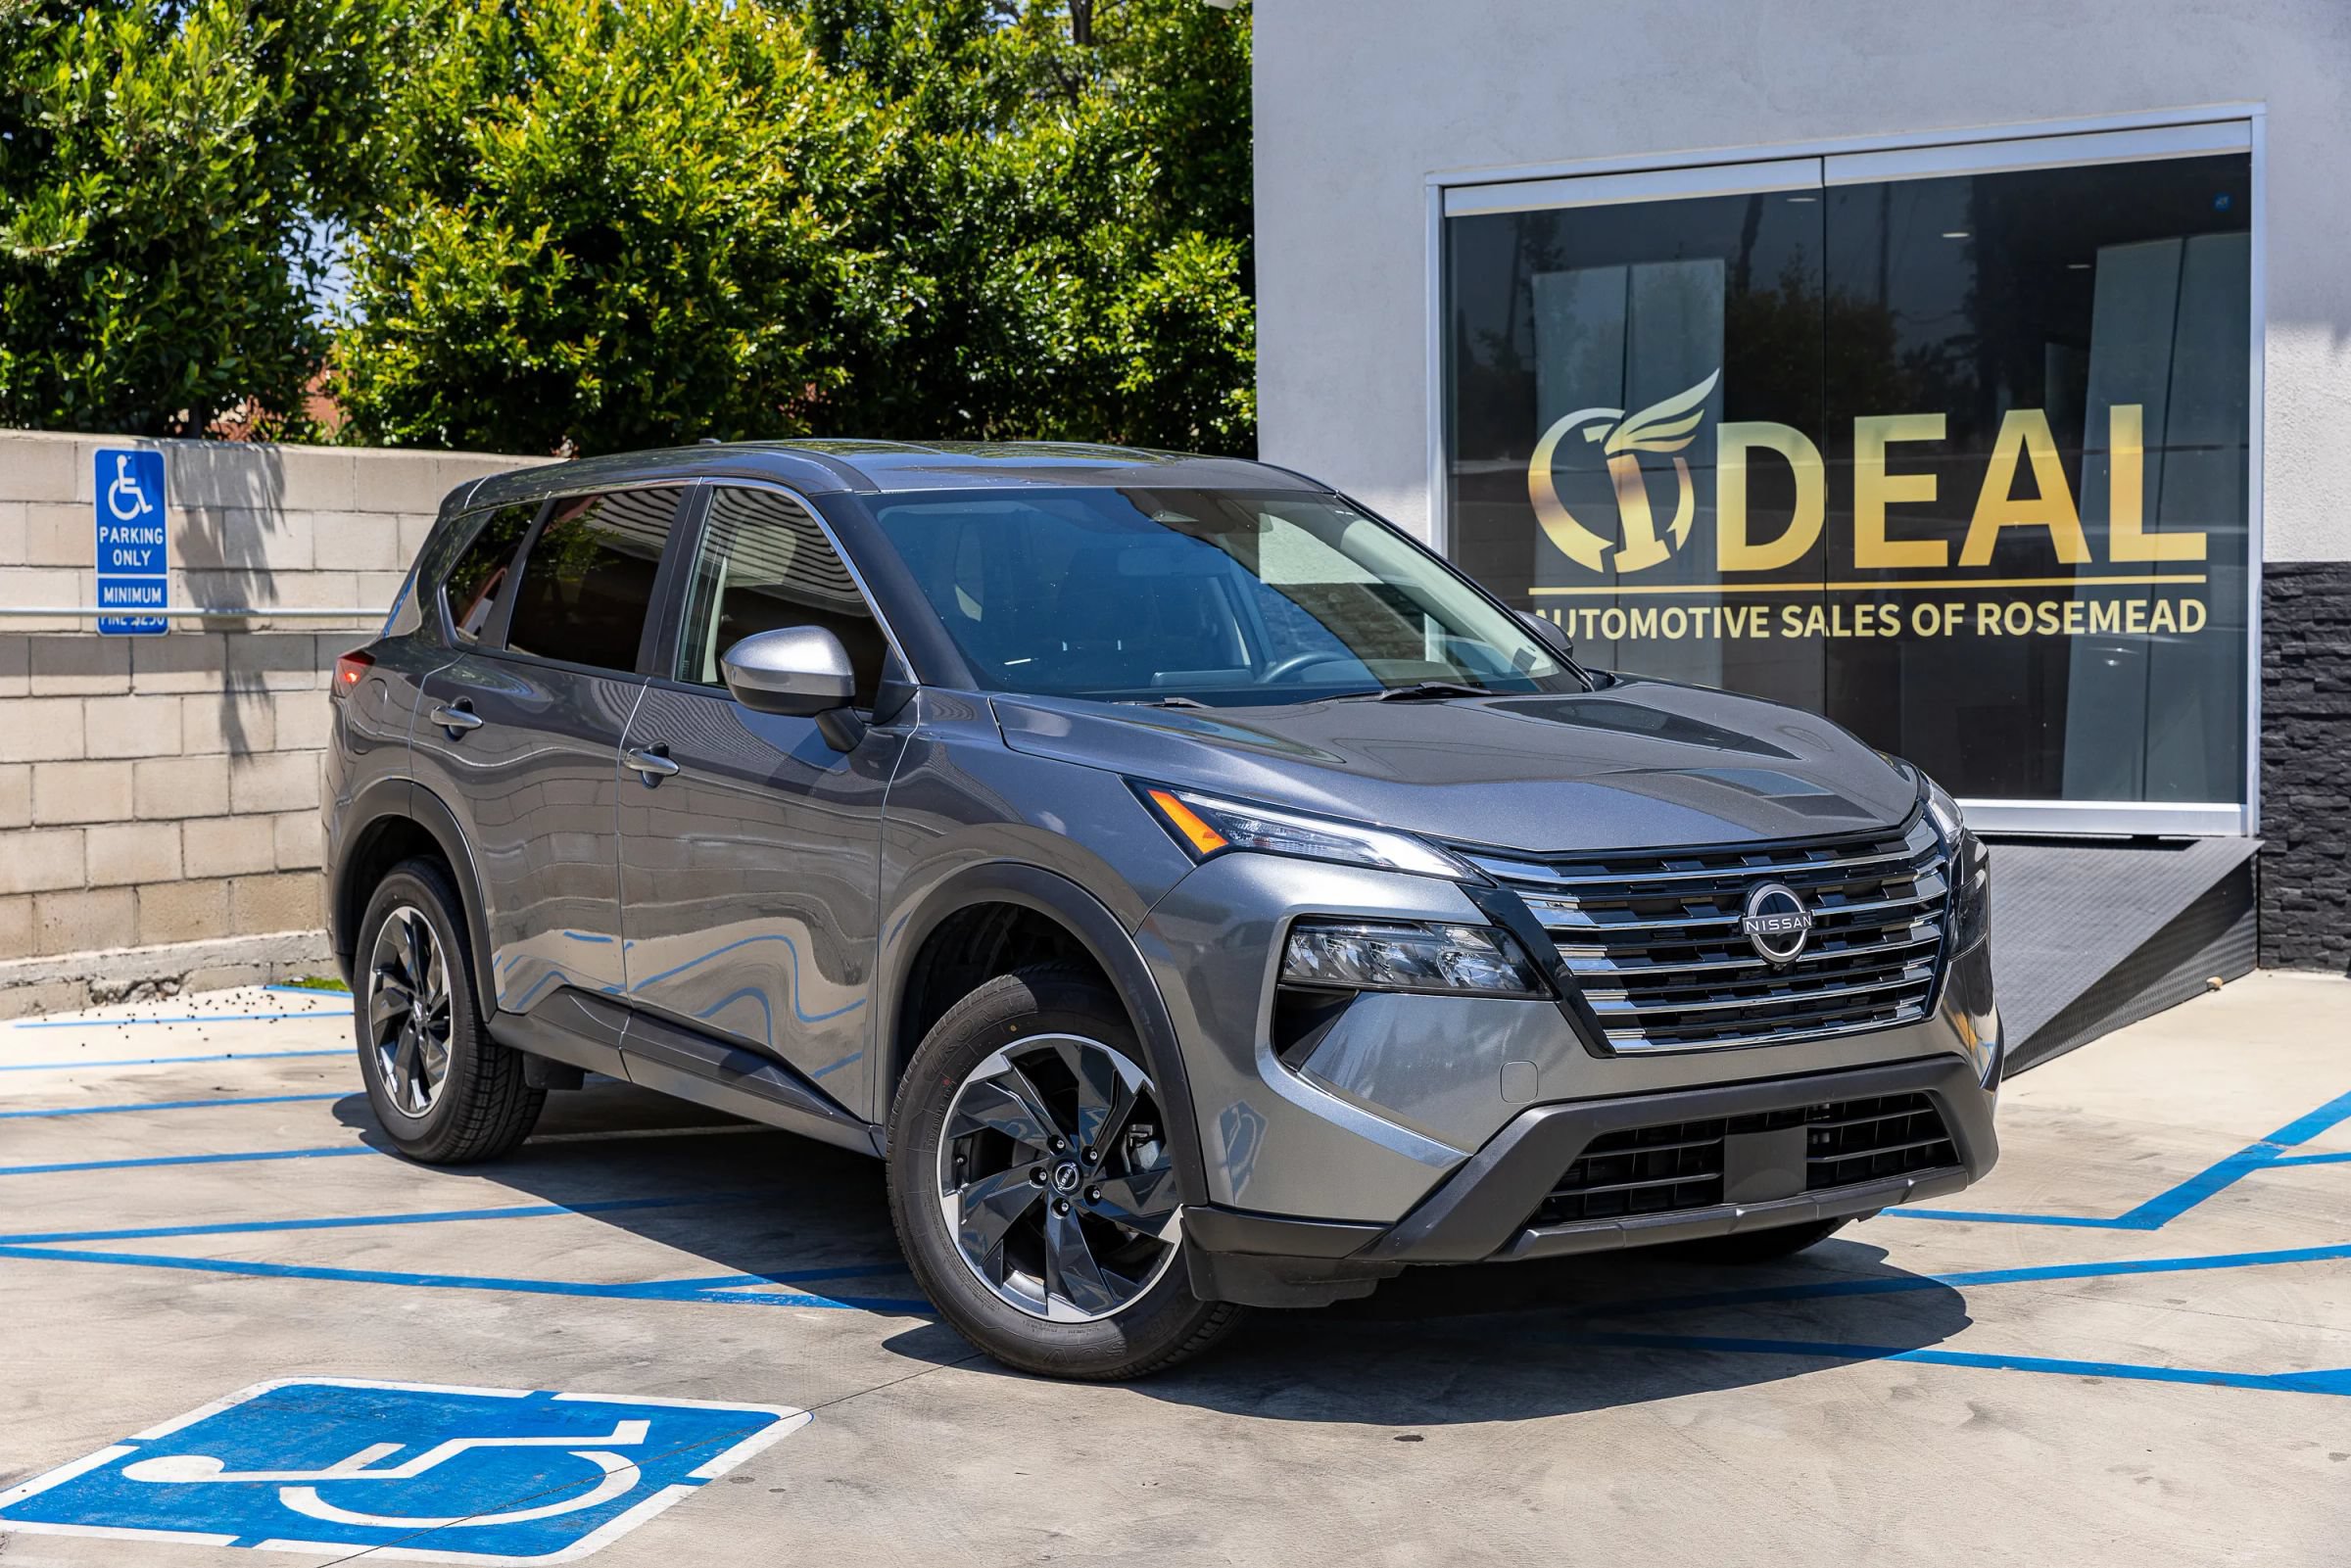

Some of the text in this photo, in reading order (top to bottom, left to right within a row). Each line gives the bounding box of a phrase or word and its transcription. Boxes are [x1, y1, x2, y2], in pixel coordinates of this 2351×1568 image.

[99, 526, 164, 545] PARKING
[113, 549, 151, 566] ONLY
[104, 586, 162, 603] MINIMUM
[1535, 598, 2207, 641] UTOMOTIVE SALES OF ROSEMEAD
[1746, 915, 1812, 932] NISSAN
[1058, 1163, 1077, 1191] NISSAN
